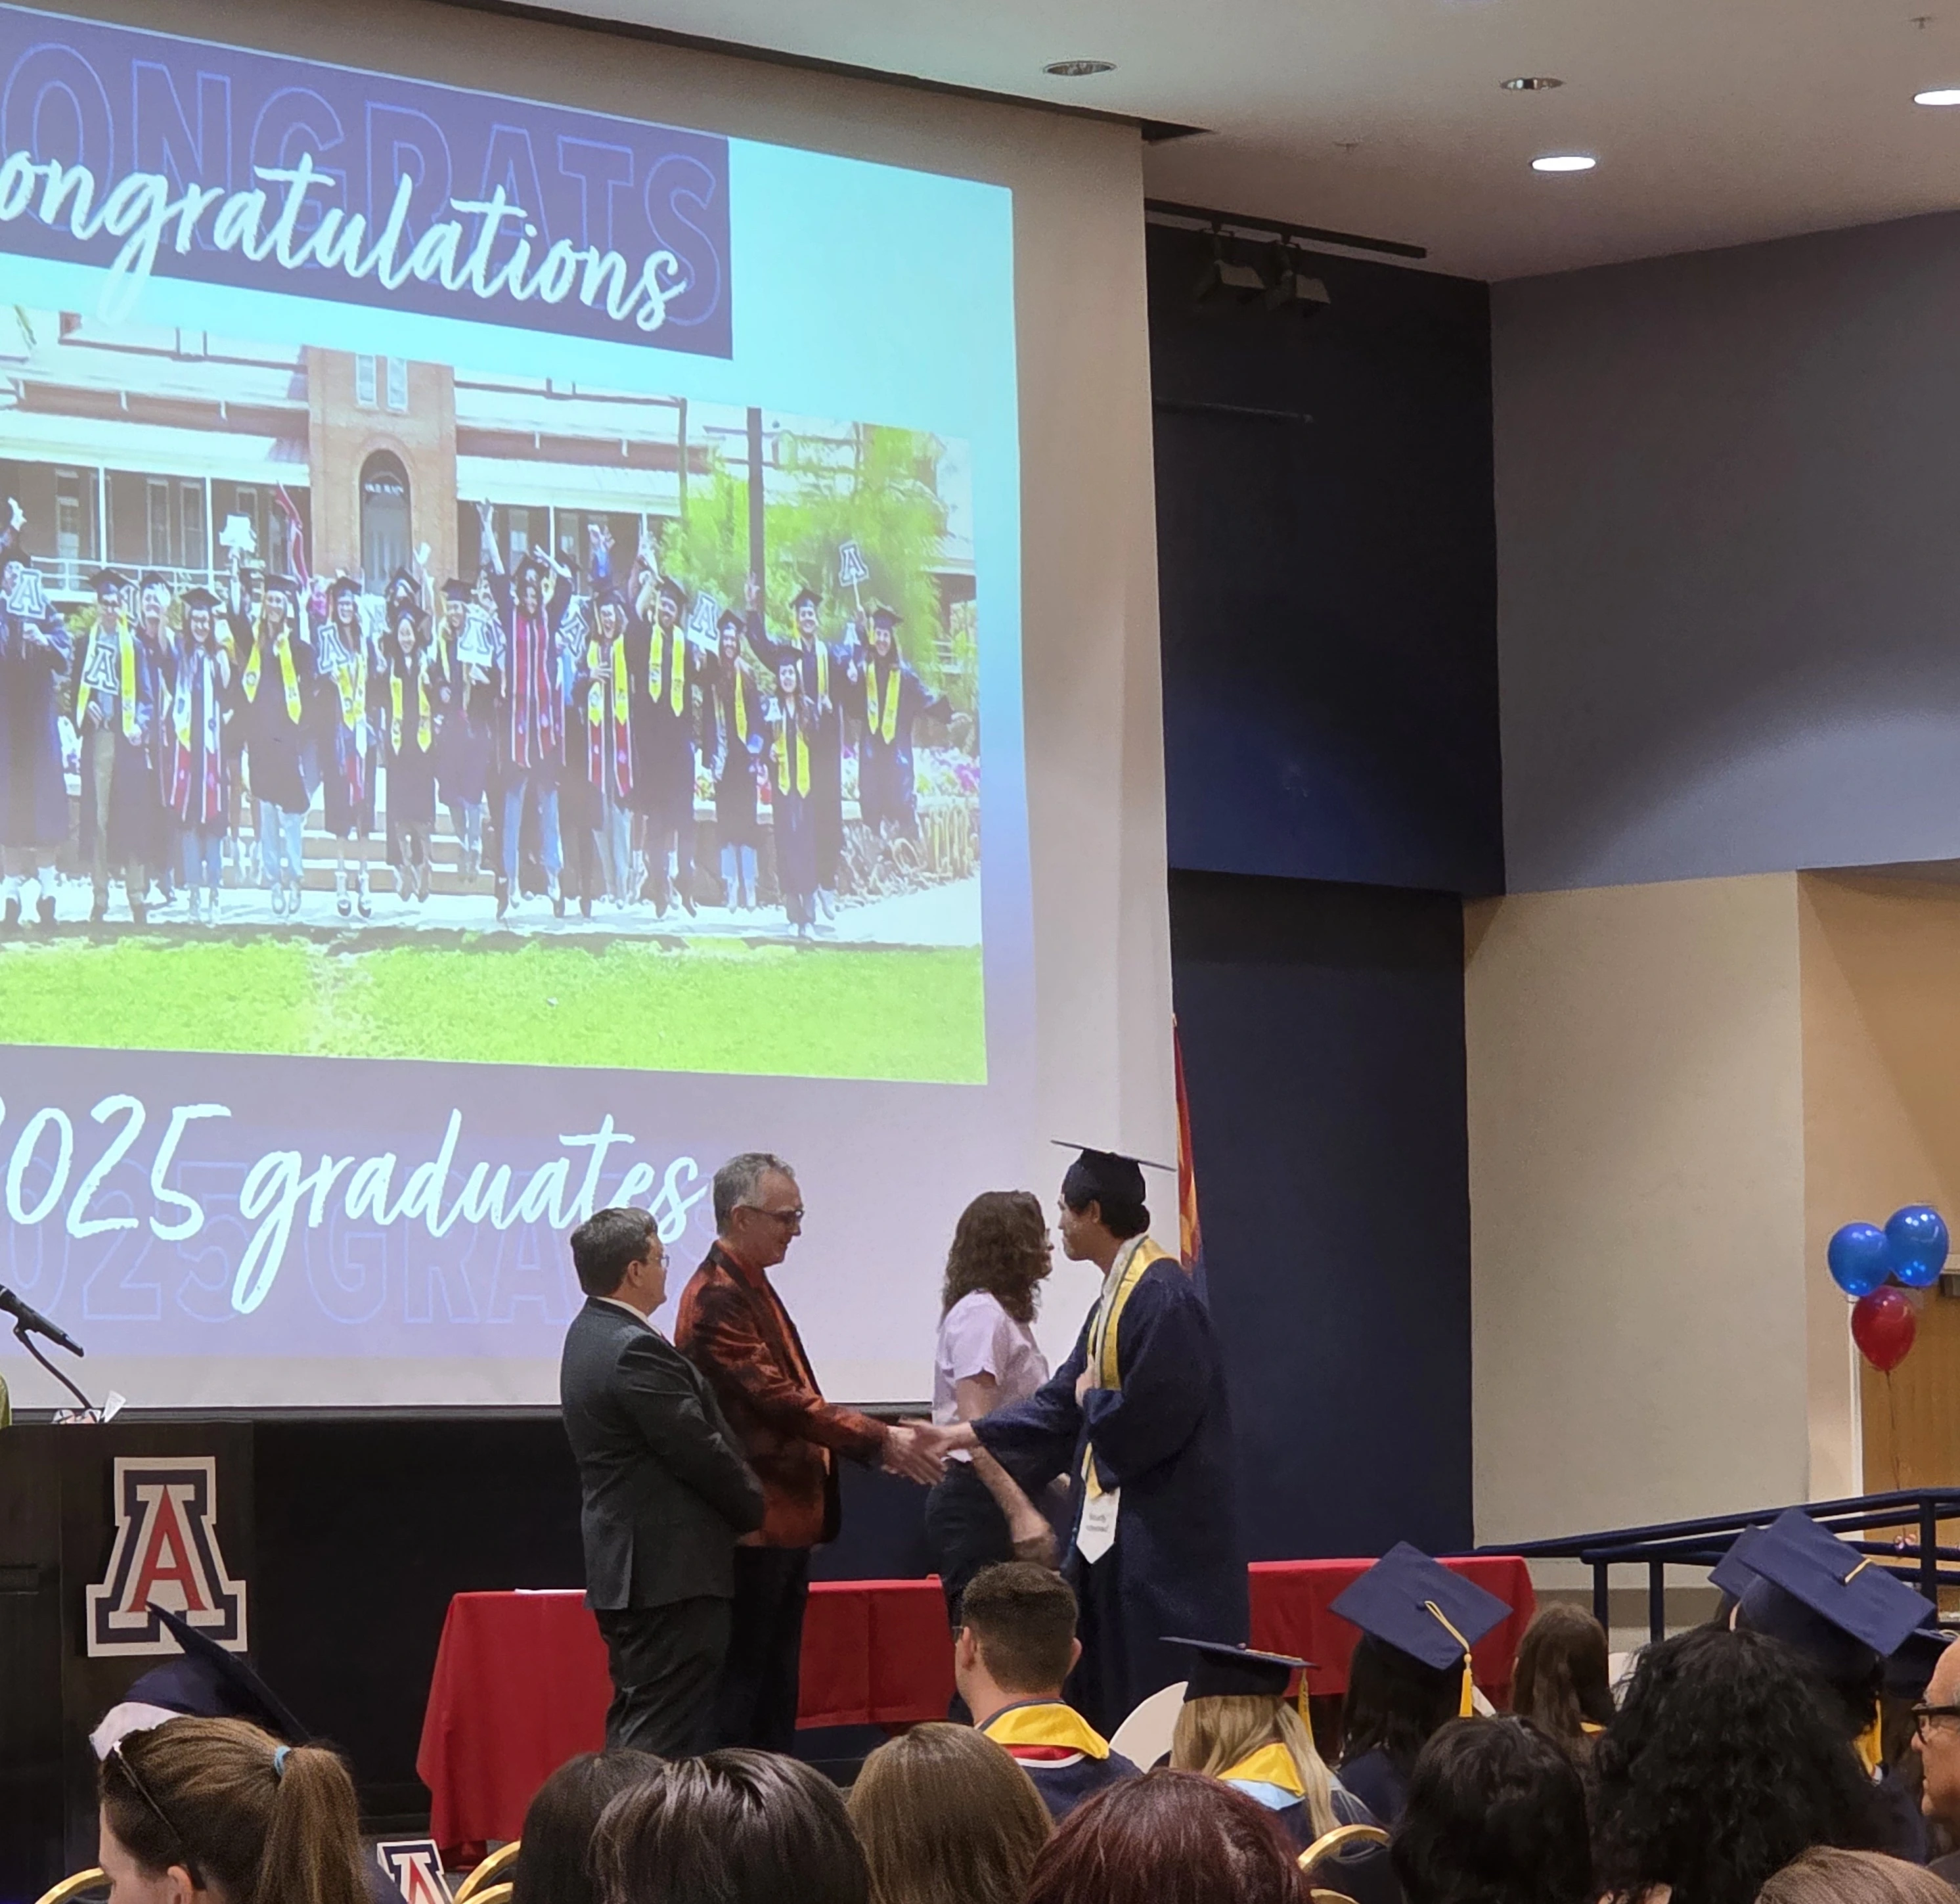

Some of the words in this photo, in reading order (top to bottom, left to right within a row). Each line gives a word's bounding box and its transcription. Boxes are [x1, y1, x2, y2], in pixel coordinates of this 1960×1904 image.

[0, 1094, 232, 1240] 025
[231, 1109, 709, 1313] graduates
[86, 1456, 248, 1657] A
